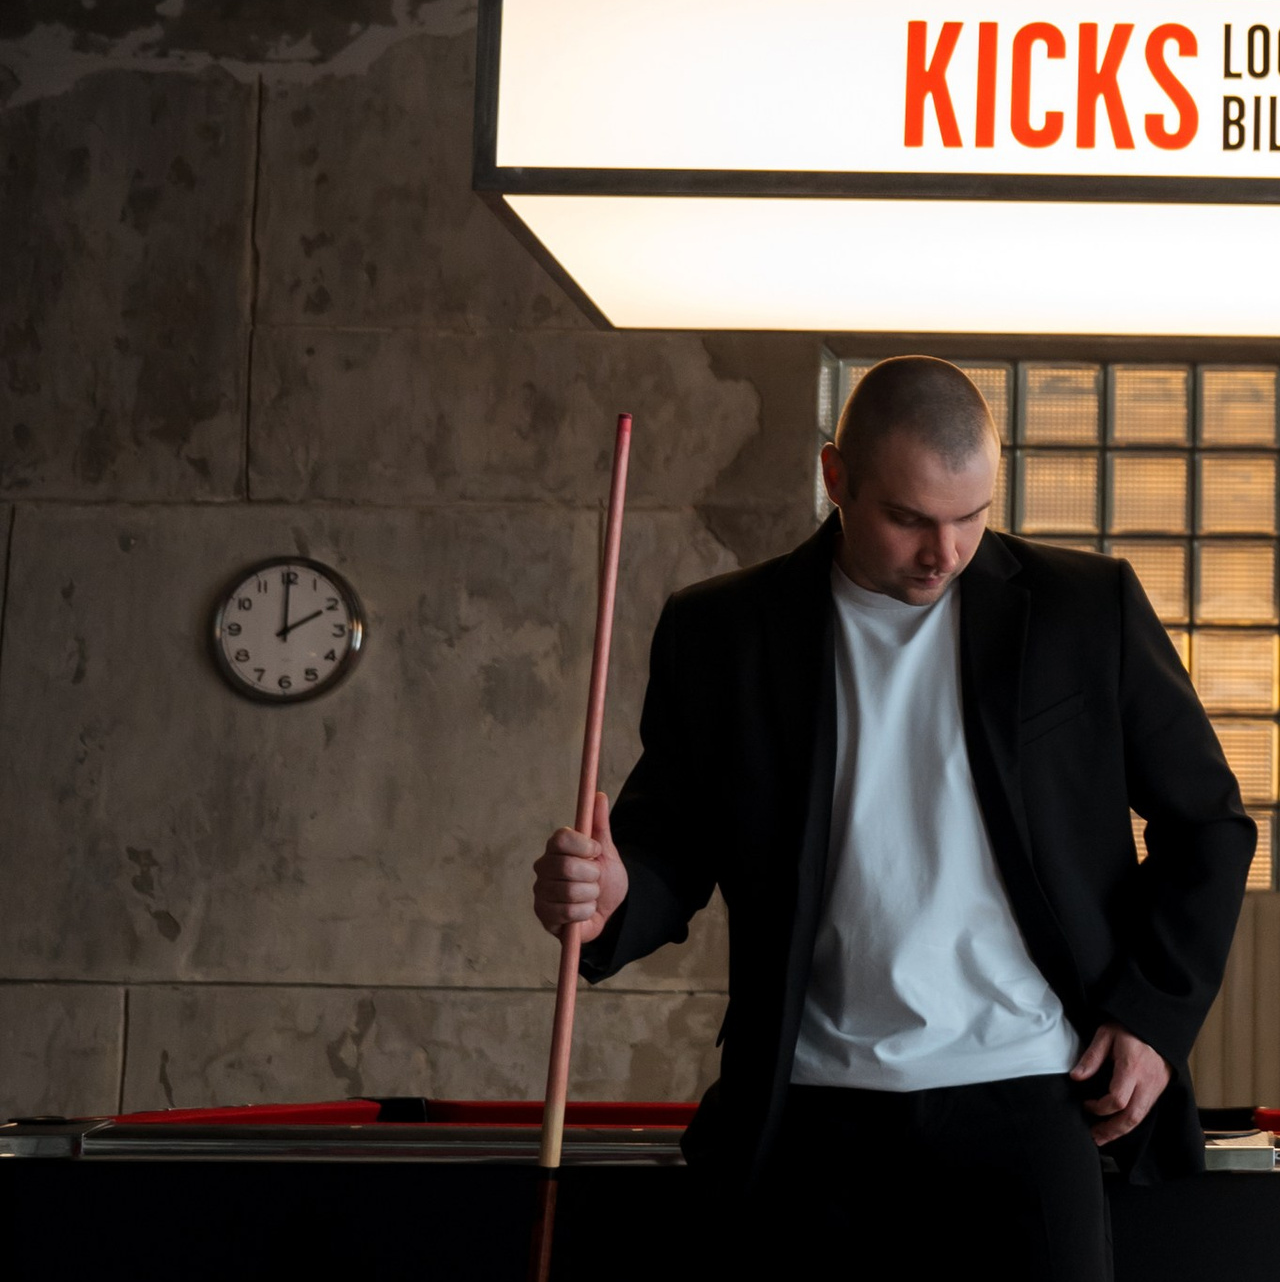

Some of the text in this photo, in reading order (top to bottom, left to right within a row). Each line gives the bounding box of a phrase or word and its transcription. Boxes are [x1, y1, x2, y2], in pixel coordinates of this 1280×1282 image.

[904, 21, 1199, 151] KICKS
[281, 571, 299, 585] 12
[313, 578, 317, 591] 1
[257, 580, 268, 593] 11
[238, 597, 252, 611] 10
[326, 598, 338, 610] 2
[227, 623, 241, 636] 9
[332, 624, 345, 637] 3
[235, 649, 250, 662] 8
[324, 649, 336, 662] 4
[253, 668, 266, 682] 7
[305, 668, 318, 682] 5
[278, 675, 291, 689] 6
